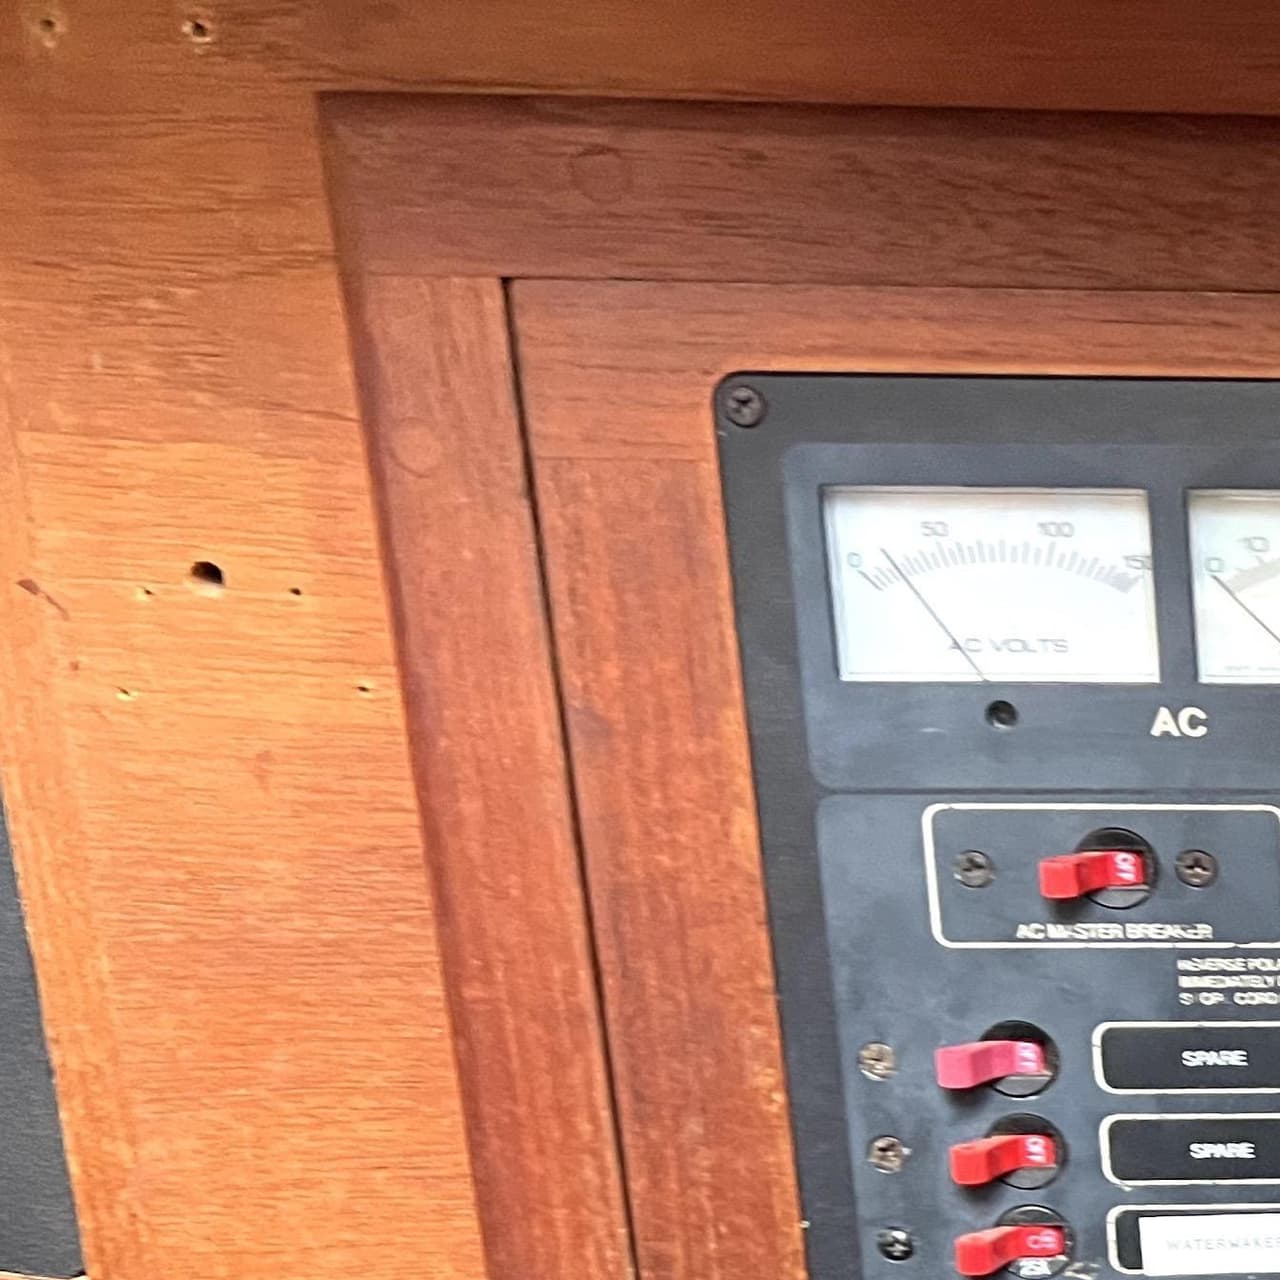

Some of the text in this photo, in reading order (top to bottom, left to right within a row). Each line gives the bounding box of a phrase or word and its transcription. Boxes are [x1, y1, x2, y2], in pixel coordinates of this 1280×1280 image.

[921, 521, 949, 537] 50
[1037, 521, 1075, 538] 100
[847, 551, 862, 568] 0
[1205, 556, 1224, 573] 0
[993, 638, 1070, 653] VOLTS
[1150, 708, 1207, 738] AC
[1016, 922, 1213, 940] AC MASTER BREAKER
[1181, 1049, 1248, 1067] SPARE
[1189, 1142, 1256, 1160] SPARE
